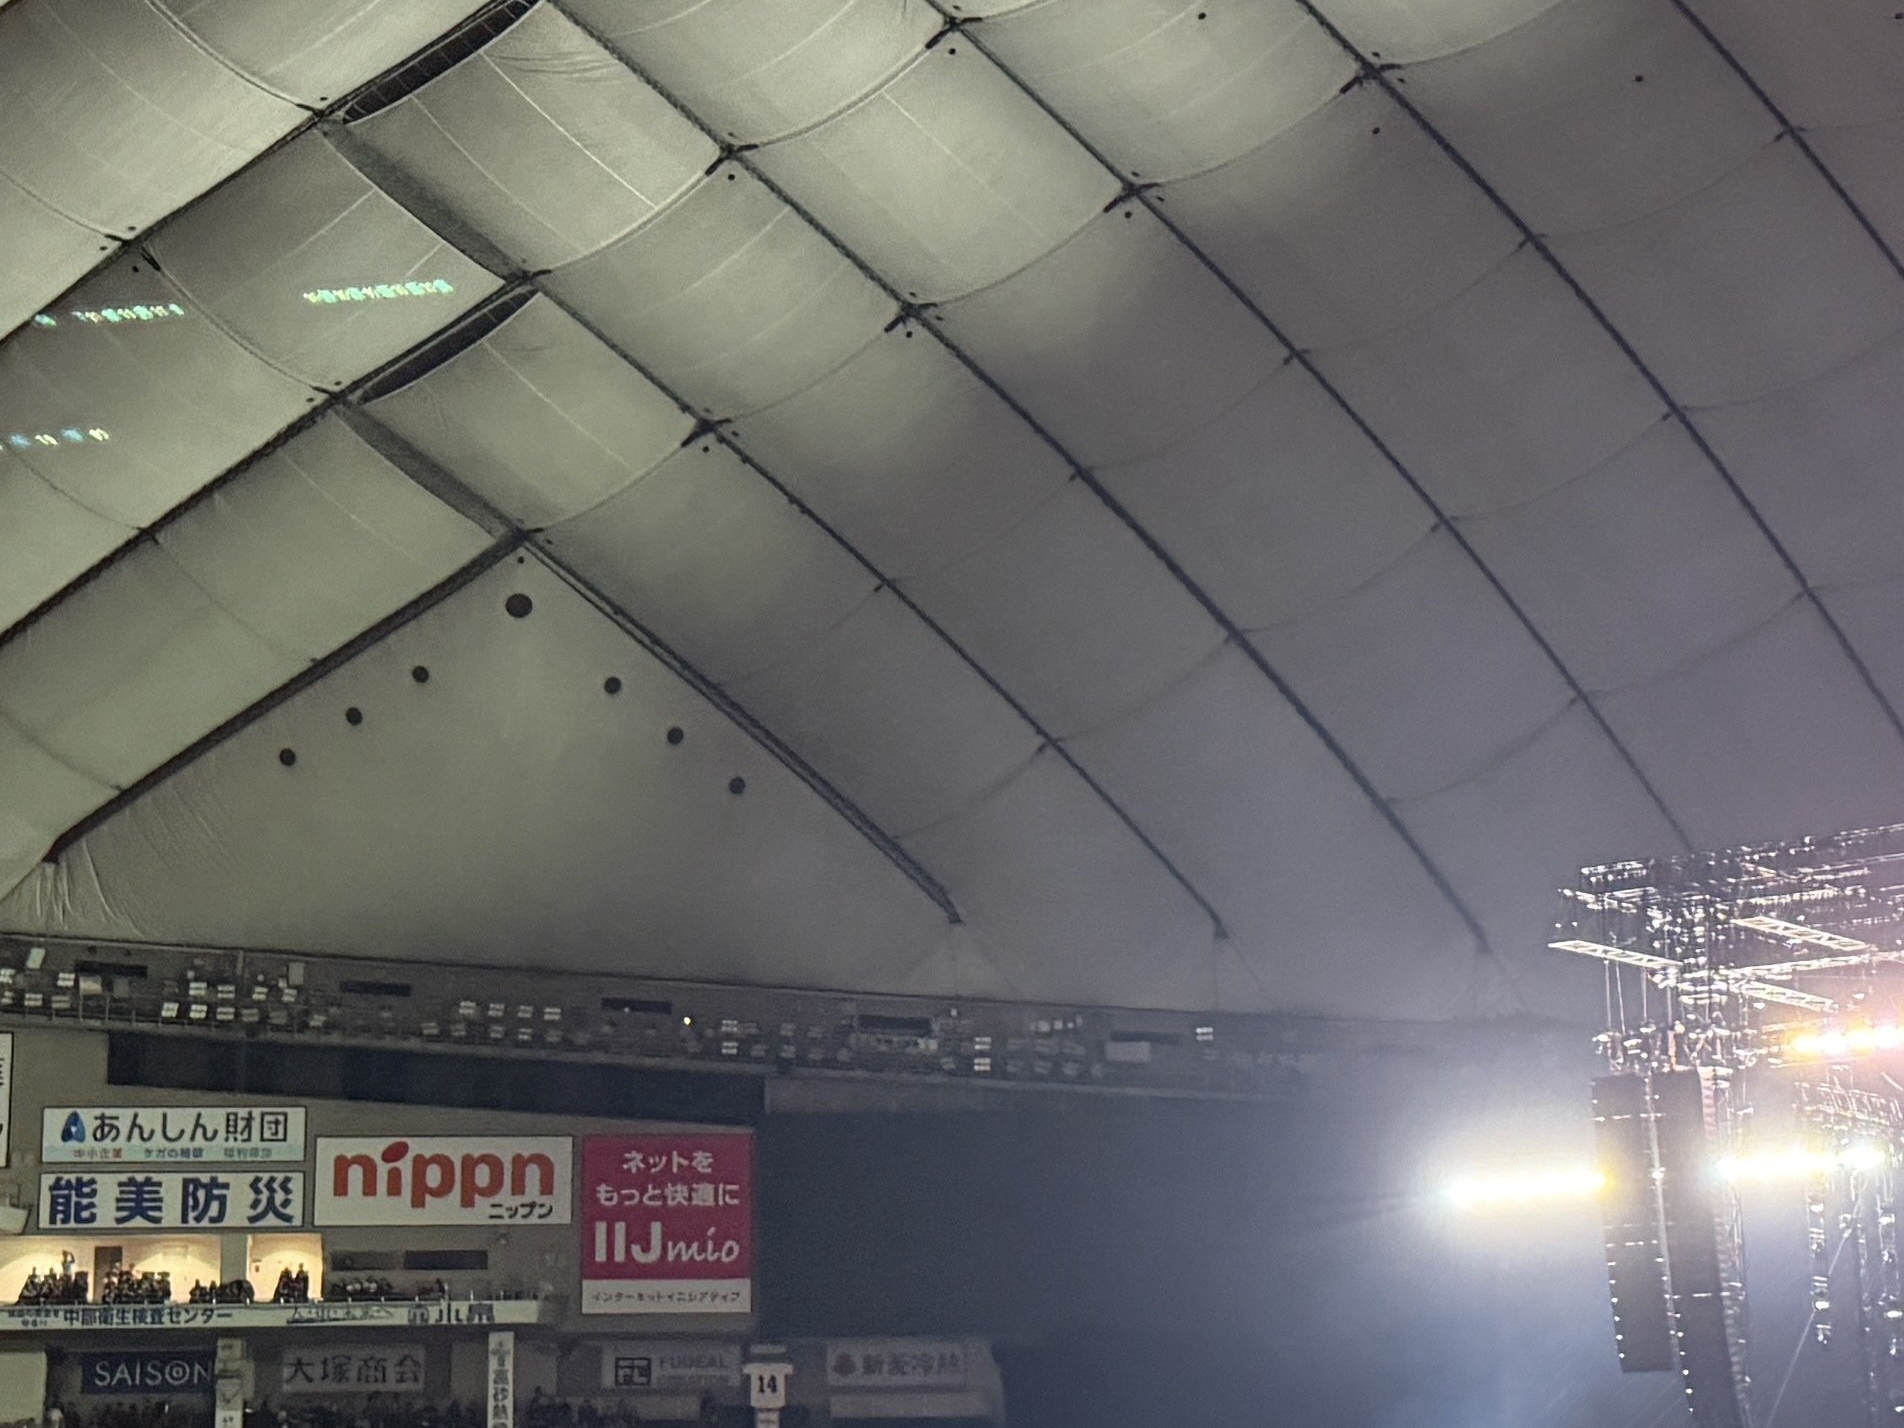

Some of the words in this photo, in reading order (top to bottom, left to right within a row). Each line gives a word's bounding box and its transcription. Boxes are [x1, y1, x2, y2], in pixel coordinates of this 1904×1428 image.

[91, 1110, 288, 1143] あんしん財団
[333, 1141, 555, 1209] nippn
[621, 1150, 714, 1174] ネットを
[48, 1175, 295, 1226] 能美防災
[596, 1182, 740, 1207] もっと快適に
[488, 1201, 553, 1220] ニップン
[595, 1221, 740, 1264] IIJmio
[283, 1354, 421, 1385] 大塚商会
[757, 1374, 778, 1394] 14
